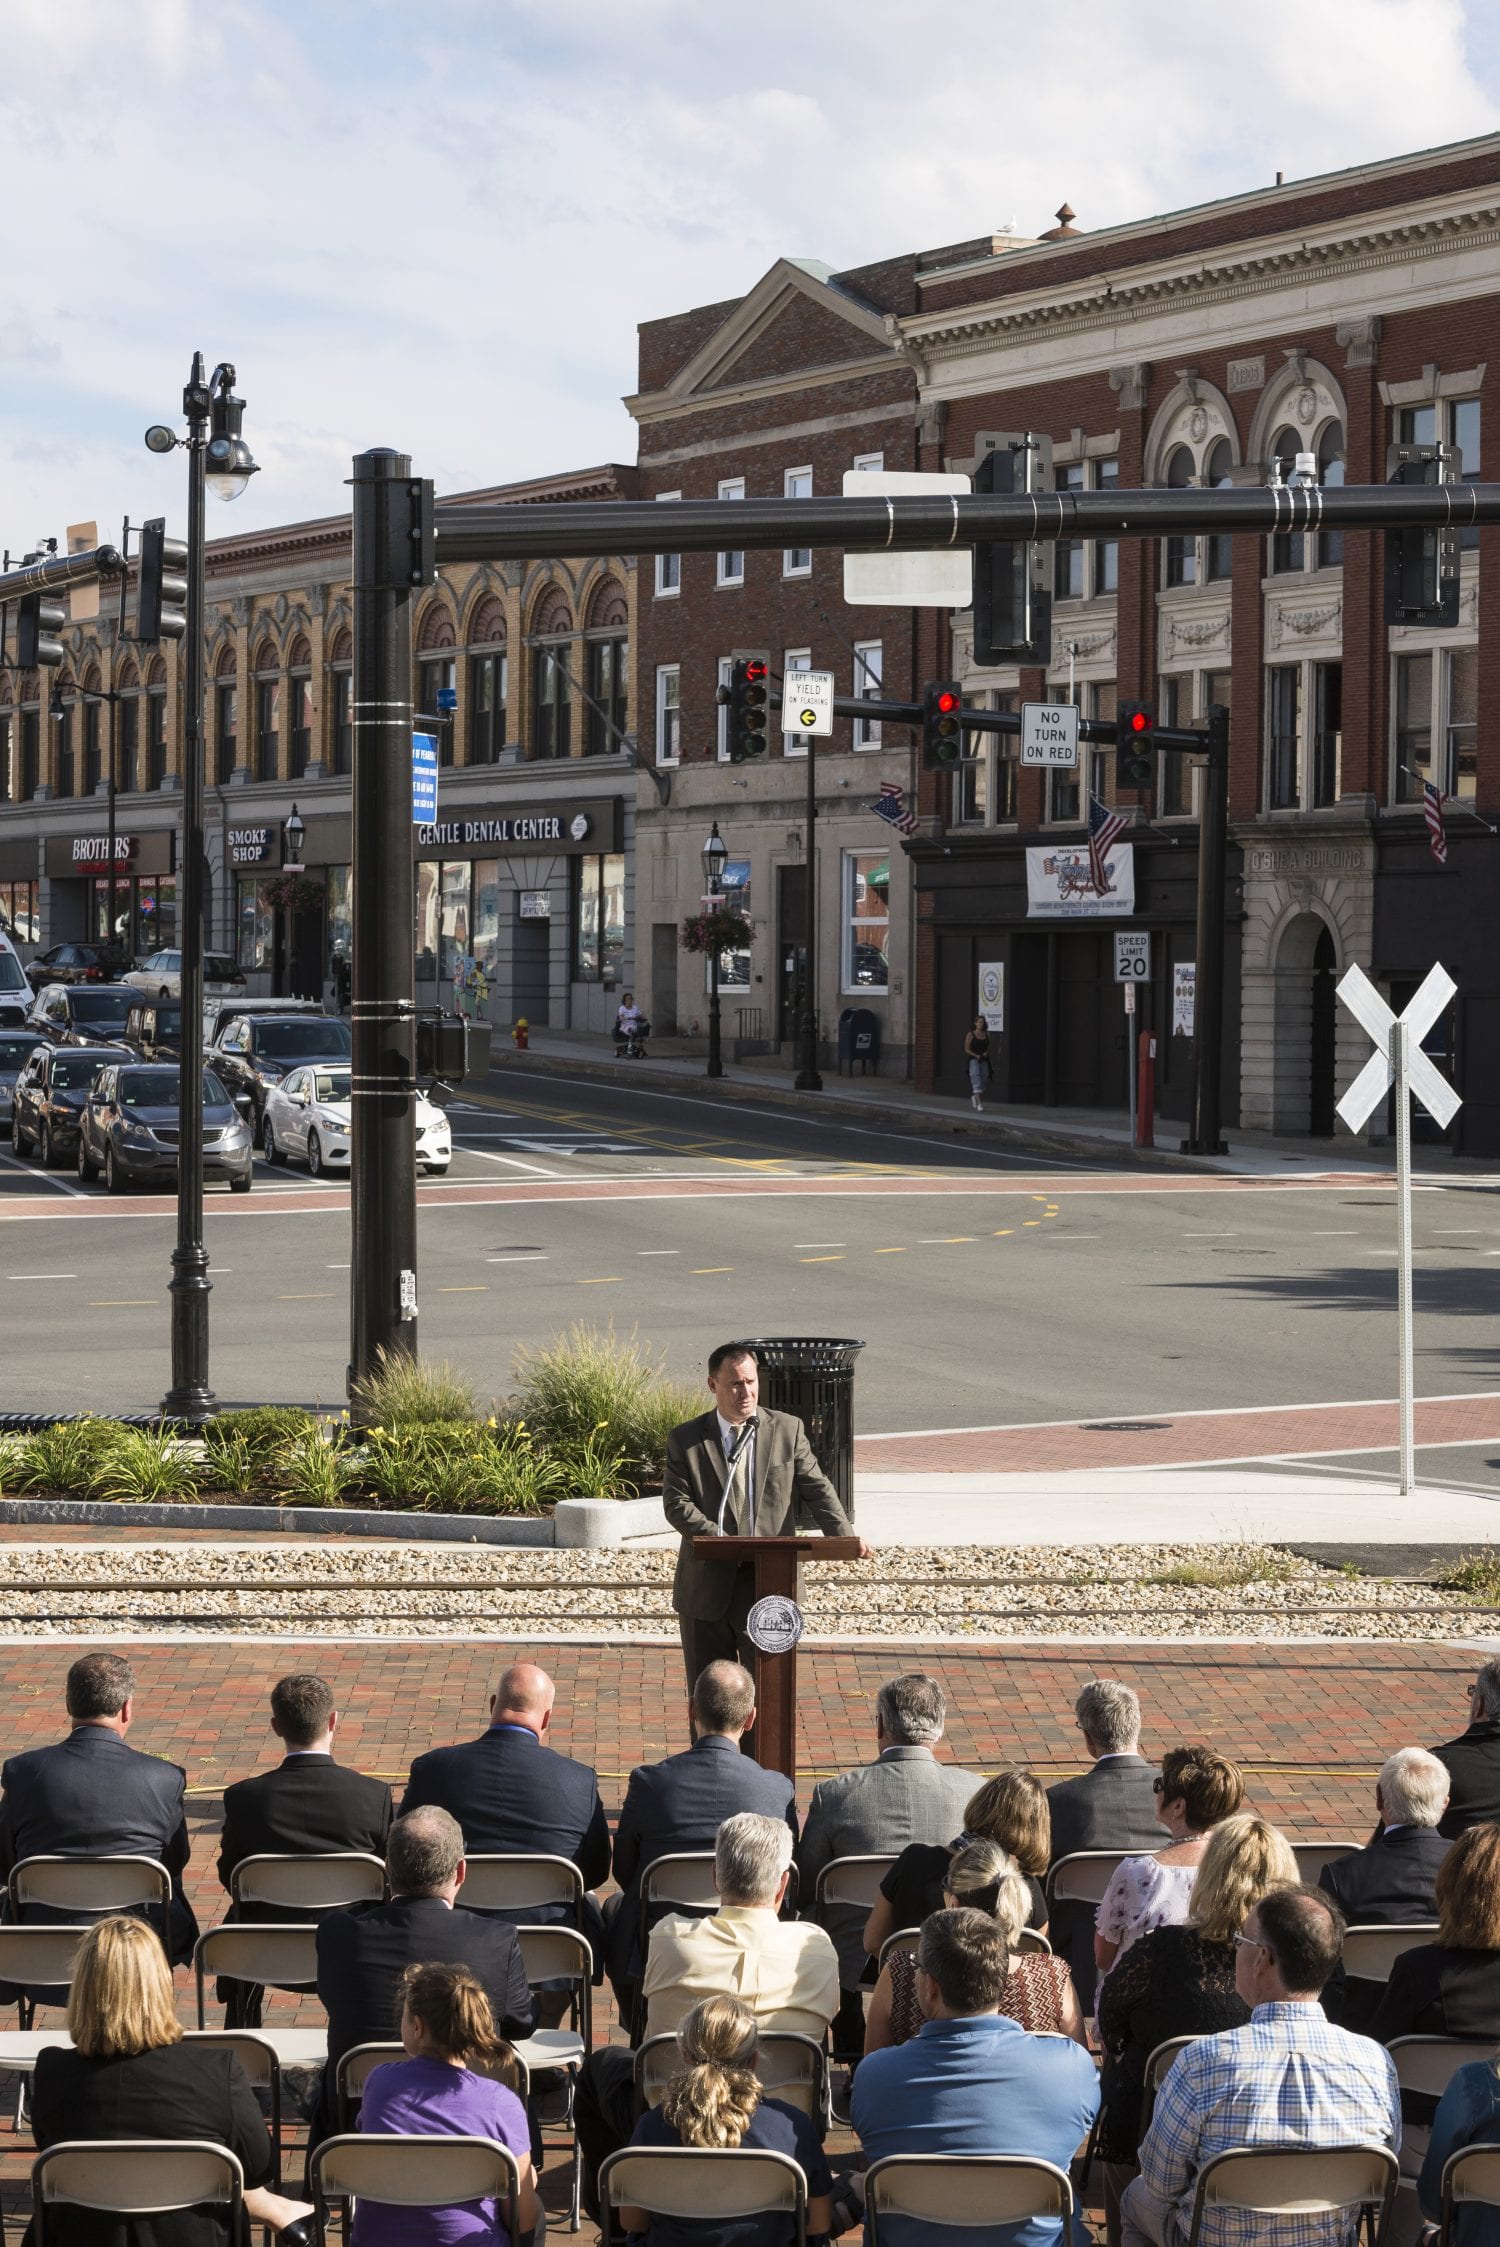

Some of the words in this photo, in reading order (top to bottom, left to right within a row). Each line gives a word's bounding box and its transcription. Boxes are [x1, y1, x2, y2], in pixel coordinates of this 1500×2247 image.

[791, 673, 807, 682] LEFT
[811, 675, 828, 683] TURN
[796, 683, 821, 695] YIELD
[789, 696, 797, 704] ON
[800, 696, 828, 706] FLASHING
[1041, 711, 1060, 724] NO
[1035, 729, 1066, 741] TURN
[1027, 746, 1043, 758] ON
[1049, 747, 1072, 759] RED
[228, 829, 266, 846] SMOKE
[418, 824, 460, 845] GENTLE
[465, 821, 509, 842] DENTAL
[514, 818, 560, 840] CENTER
[72, 837, 130, 860] BROTHRS
[233, 847, 263, 862] SHOP
[1304, 848, 1362, 868] BUILDING
[116, 879, 130, 888] LUNCH
[139, 878, 156, 887] DINNER
[1118, 936, 1147, 945] SPEED
[1121, 948, 1144, 956] LIMIT
[1119, 958, 1146, 976] 20
